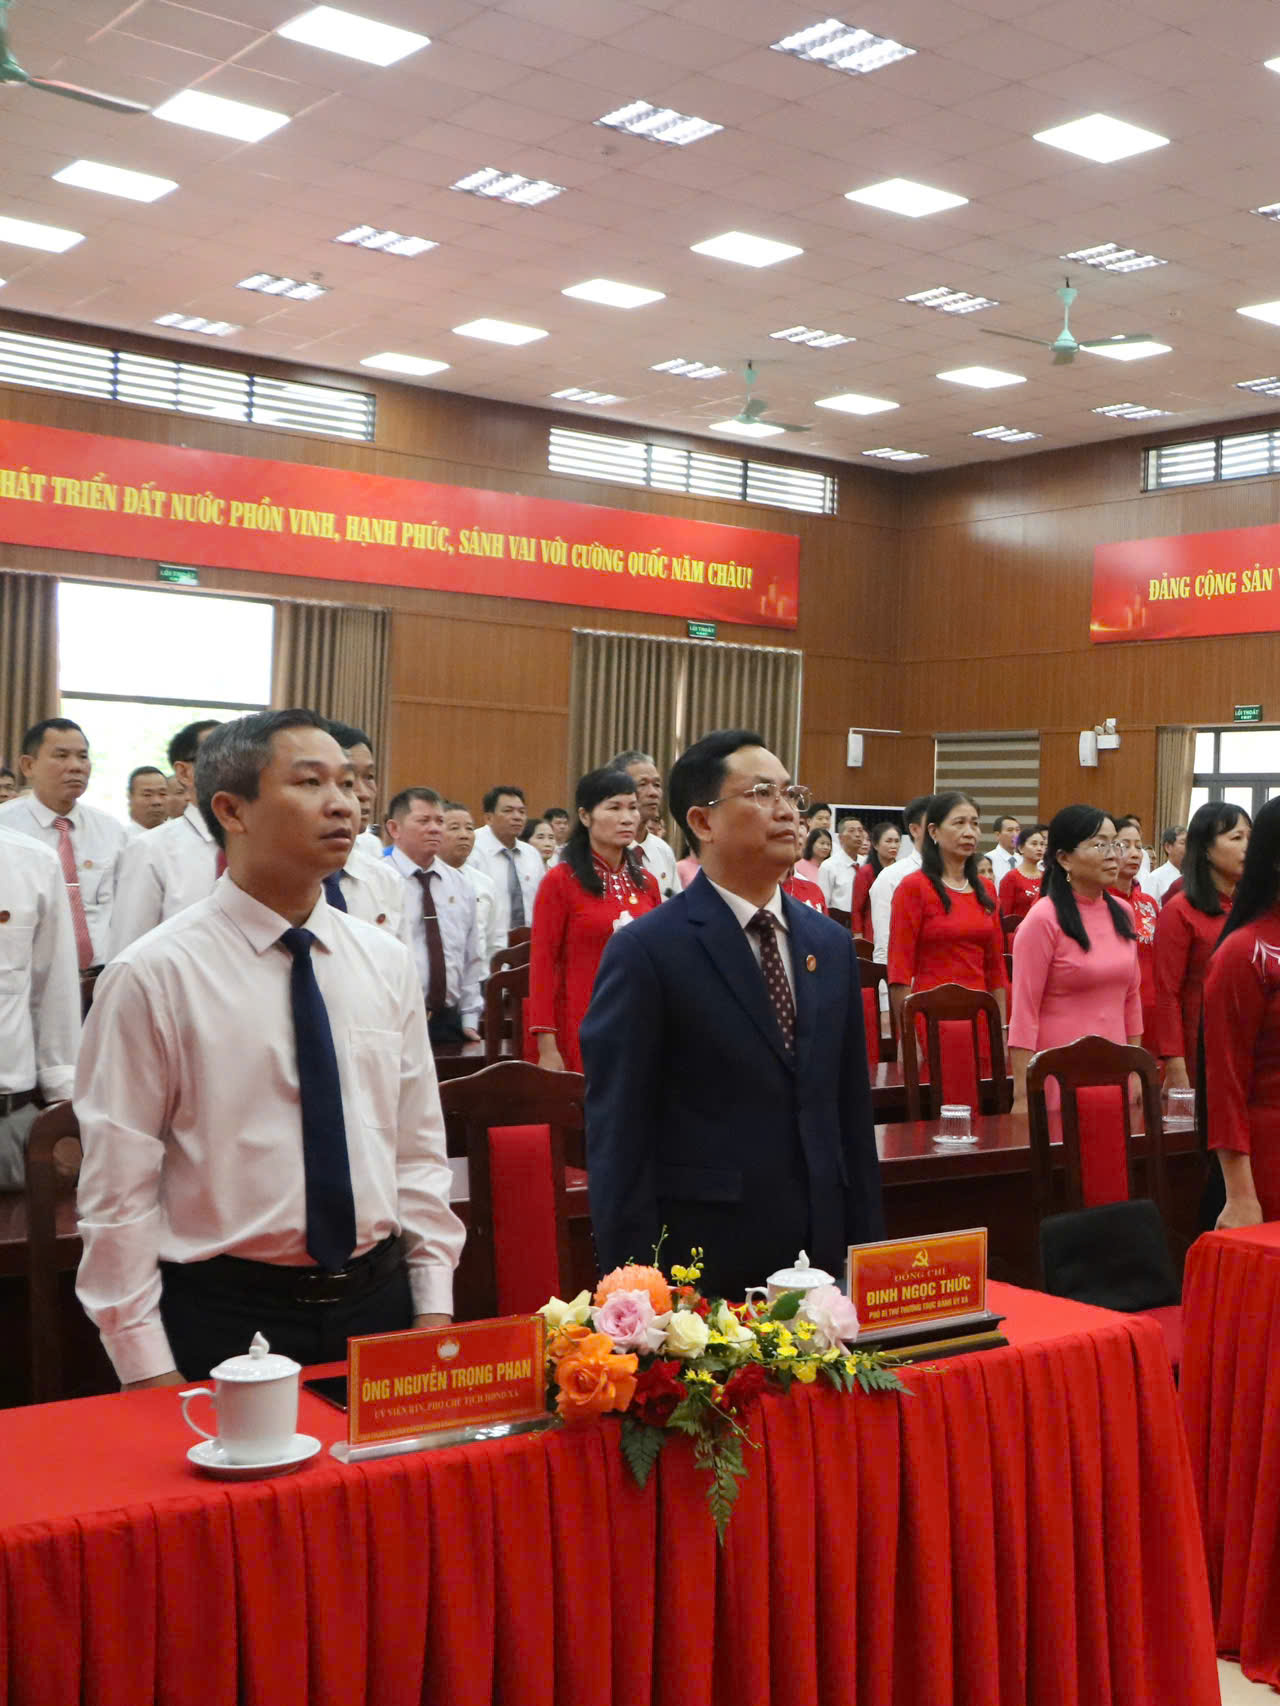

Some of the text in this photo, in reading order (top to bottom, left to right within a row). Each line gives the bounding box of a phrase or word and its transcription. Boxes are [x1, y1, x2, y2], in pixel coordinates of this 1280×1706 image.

[51, 472, 118, 512] TRIỂN
[123, 481, 167, 518] ĐẤT
[170, 491, 226, 525] NƯỚC
[288, 508, 342, 543] VINH,
[345, 515, 398, 547] HẠNH
[401, 520, 455, 556] PHÚC,
[458, 526, 504, 558] SÁNH
[508, 535, 537, 562] VAI
[571, 541, 624, 573] CƯỜNG
[627, 547, 669, 579] QUỐC
[671, 554, 704, 584] NĂM
[707, 560, 753, 590] CHÂU!
[1148, 572, 1191, 601] ĐẢNG
[1194, 569, 1237, 600] CỘNG
[1241, 563, 1273, 593] SẢN
[902, 1281, 937, 1301] NGỌC
[362, 1359, 531, 1402] ÔNG NGUYỄN TRỌNG PHAN
